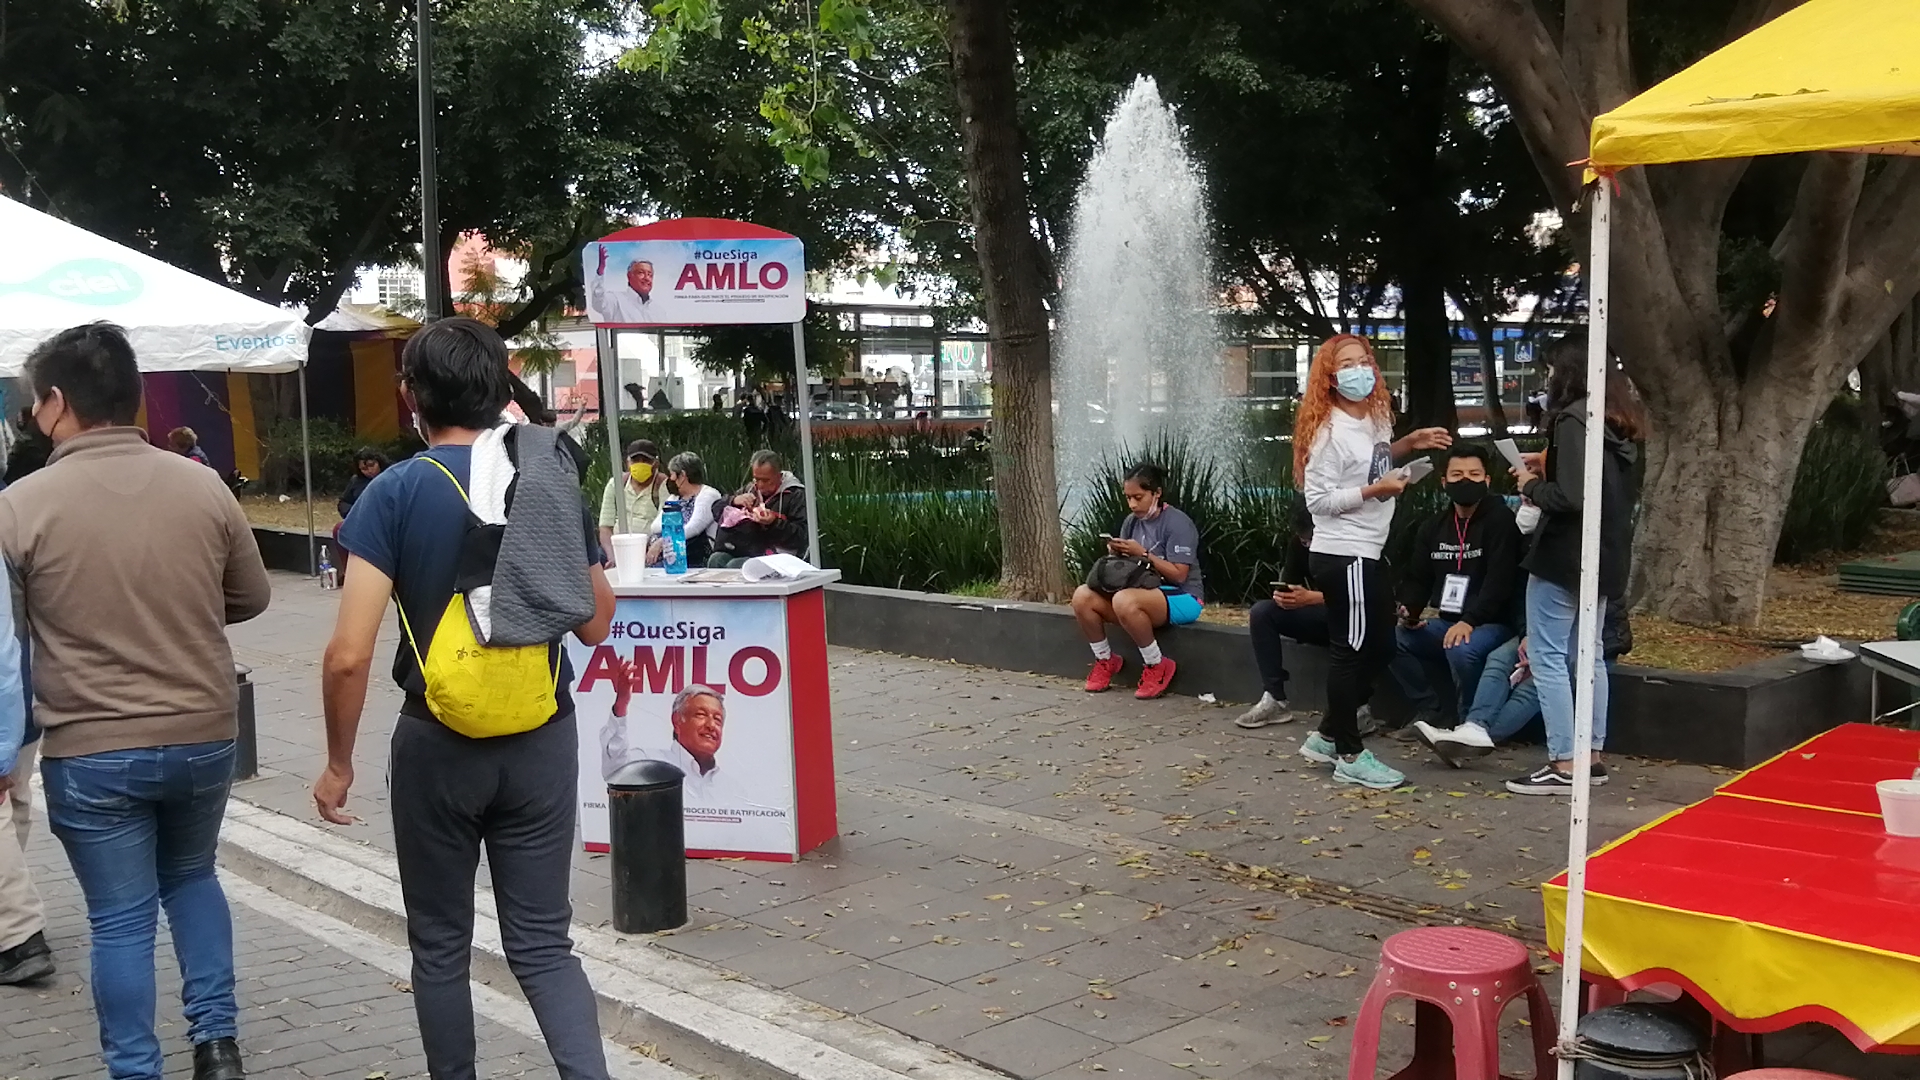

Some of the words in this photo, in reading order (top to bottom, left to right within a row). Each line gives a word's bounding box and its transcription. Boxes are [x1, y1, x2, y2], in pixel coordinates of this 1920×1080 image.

[694, 249, 758, 262] #QueSiga
[48, 268, 132, 297] ciel
[674, 262, 789, 290] AMLO
[215, 333, 297, 351] Eventos
[611, 620, 726, 645] #QueSiga
[576, 645, 782, 697] AMLO
[718, 808, 728, 816] DE
[730, 809, 787, 818] RATIFICACIÓN
